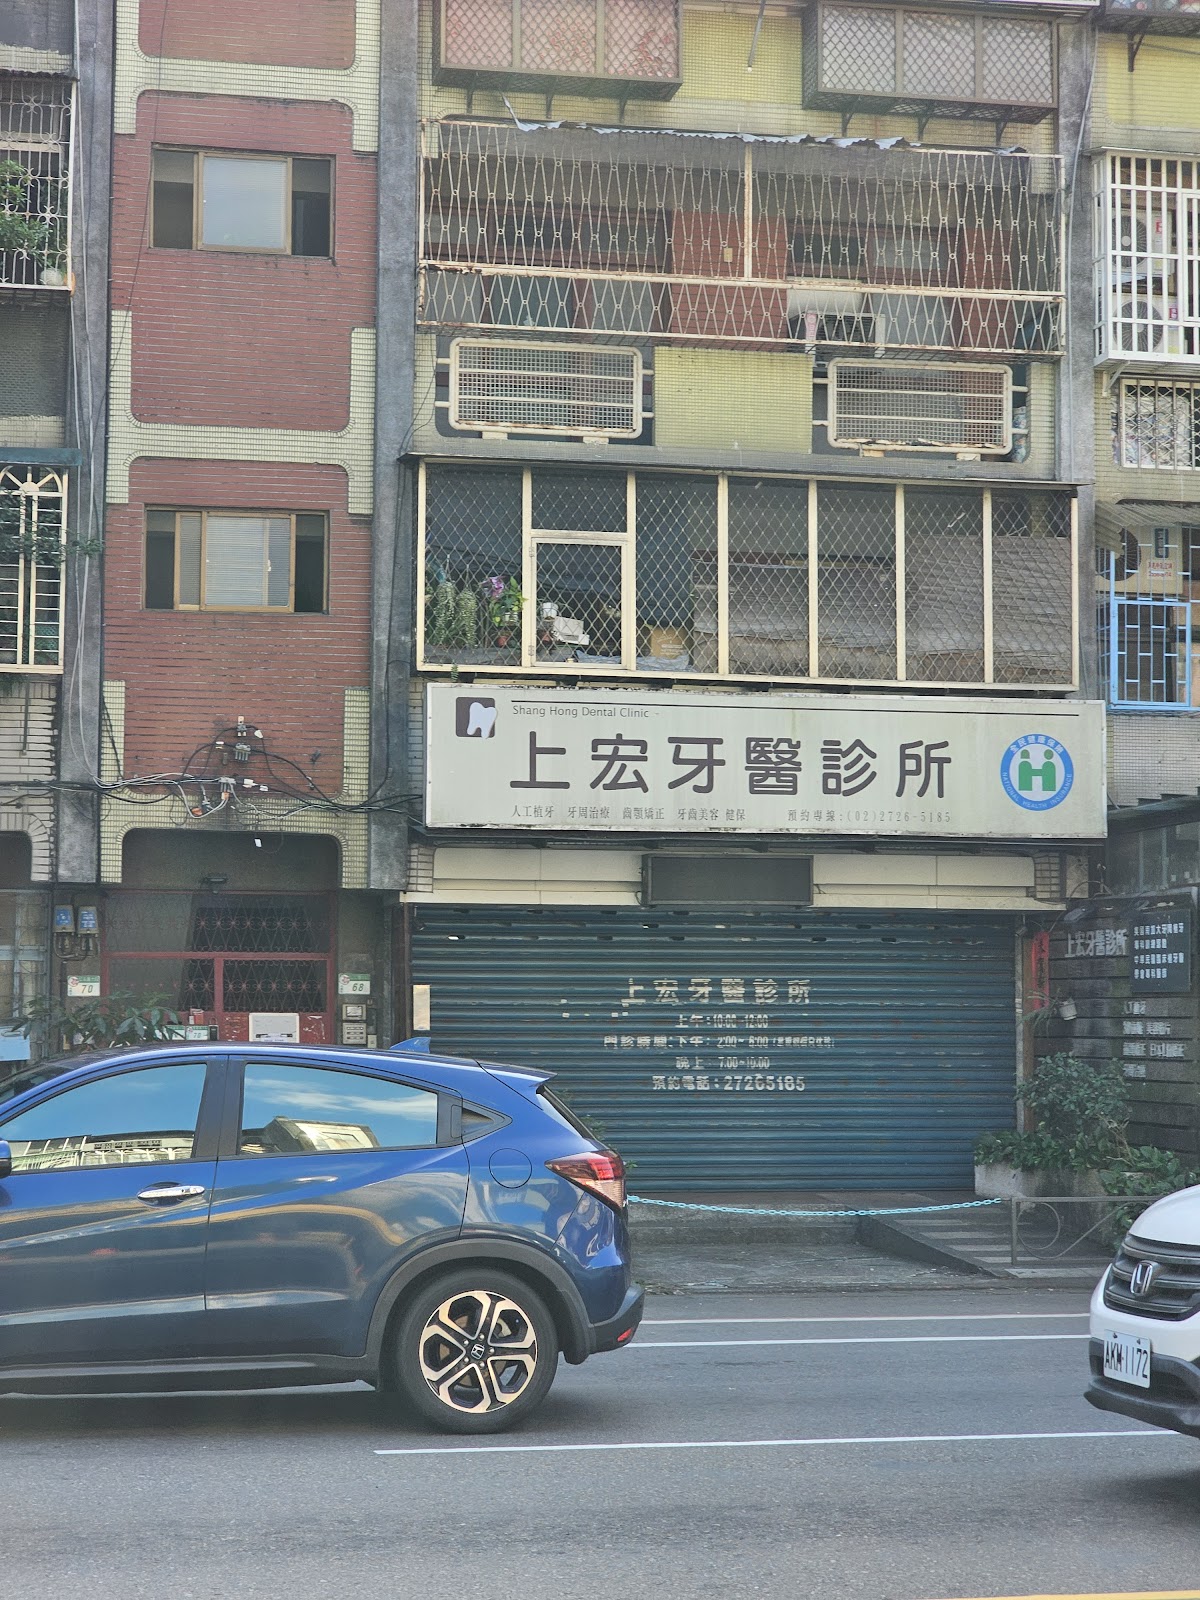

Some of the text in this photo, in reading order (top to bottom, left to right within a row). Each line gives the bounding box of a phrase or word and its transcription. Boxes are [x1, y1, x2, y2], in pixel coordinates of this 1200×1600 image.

[512, 705, 650, 719] Shang Hong Dental Clinic
[510, 731, 952, 798] 上宏牙醫診所
[1002, 771, 1020, 802] NATIONAL
[1022, 801, 1048, 809] HEALTH
[511, 804, 555, 819] 人工植牙
[567, 805, 611, 820] 牙周治療
[677, 807, 719, 821] 牙齒美容
[725, 808, 747, 821] 健保
[81, 984, 94, 994] 70
[352, 982, 364, 992] 68
[620, 977, 811, 1005] 上宏牙醫診所
